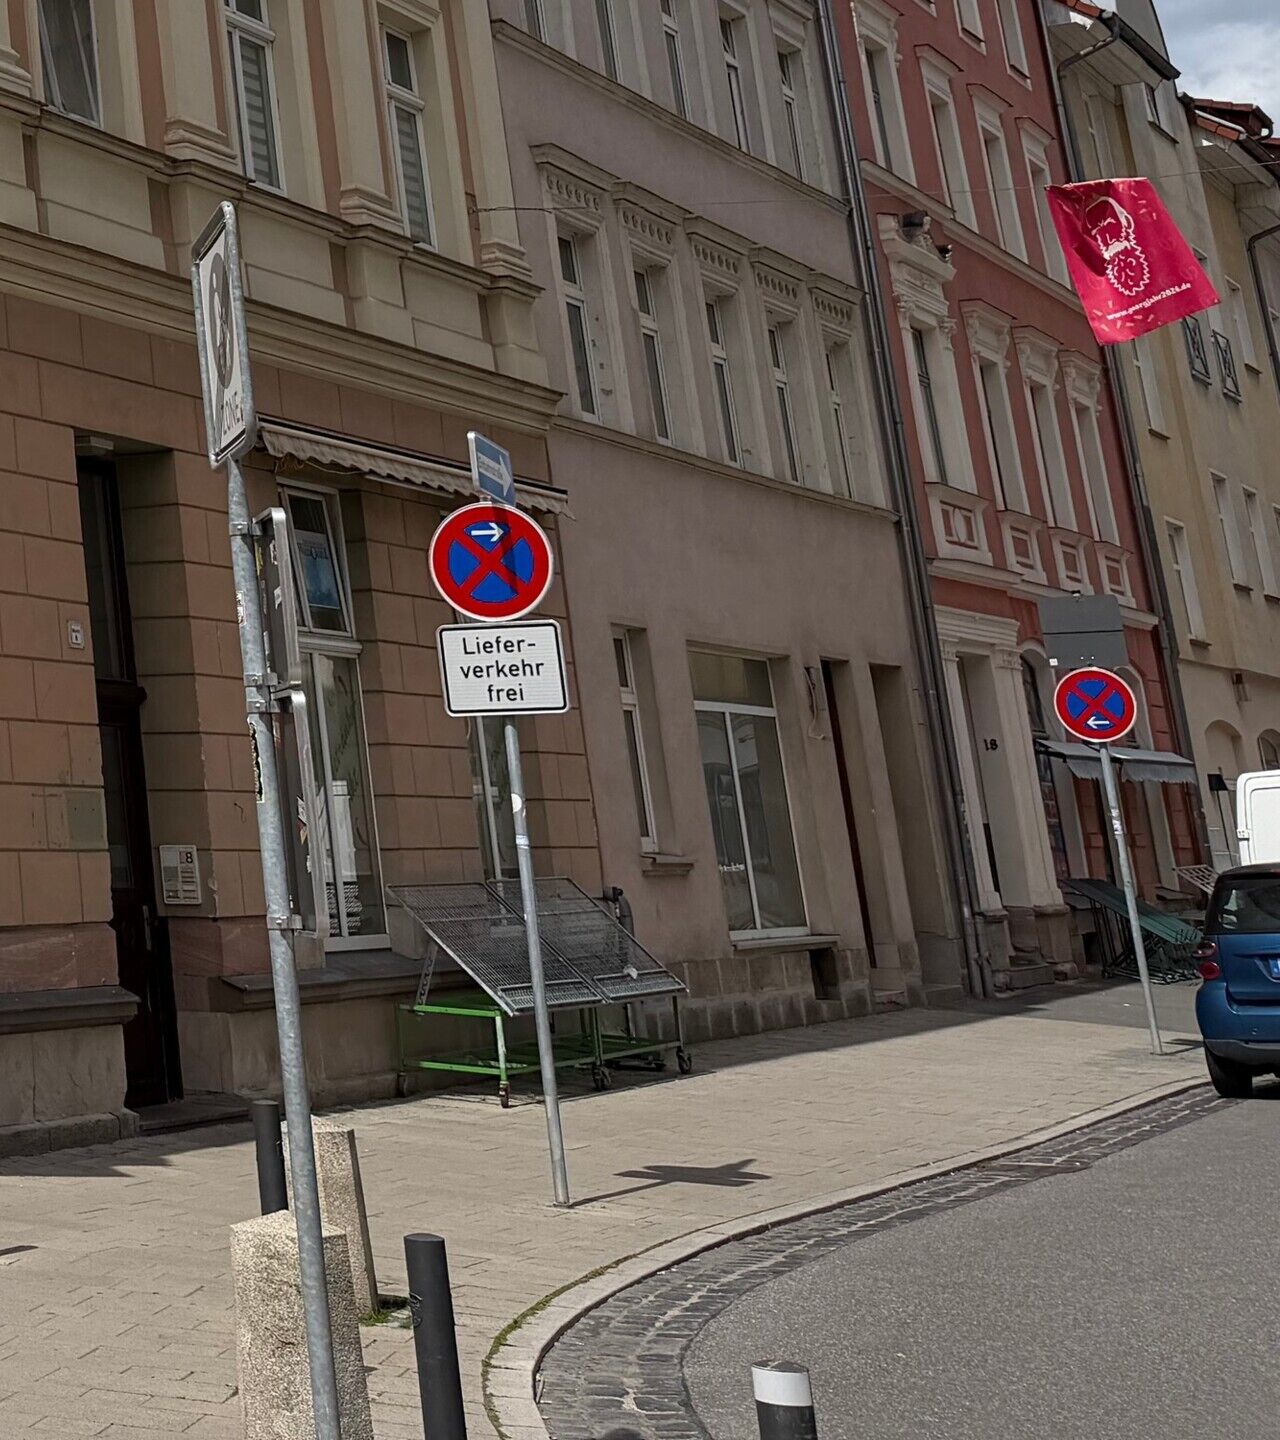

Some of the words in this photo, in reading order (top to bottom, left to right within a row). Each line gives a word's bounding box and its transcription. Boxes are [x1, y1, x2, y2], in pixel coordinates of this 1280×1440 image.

[462, 635, 536, 655] Liefer-
[460, 658, 545, 679] verkehr
[487, 682, 525, 702] frei
[185, 851, 194, 864] 8
